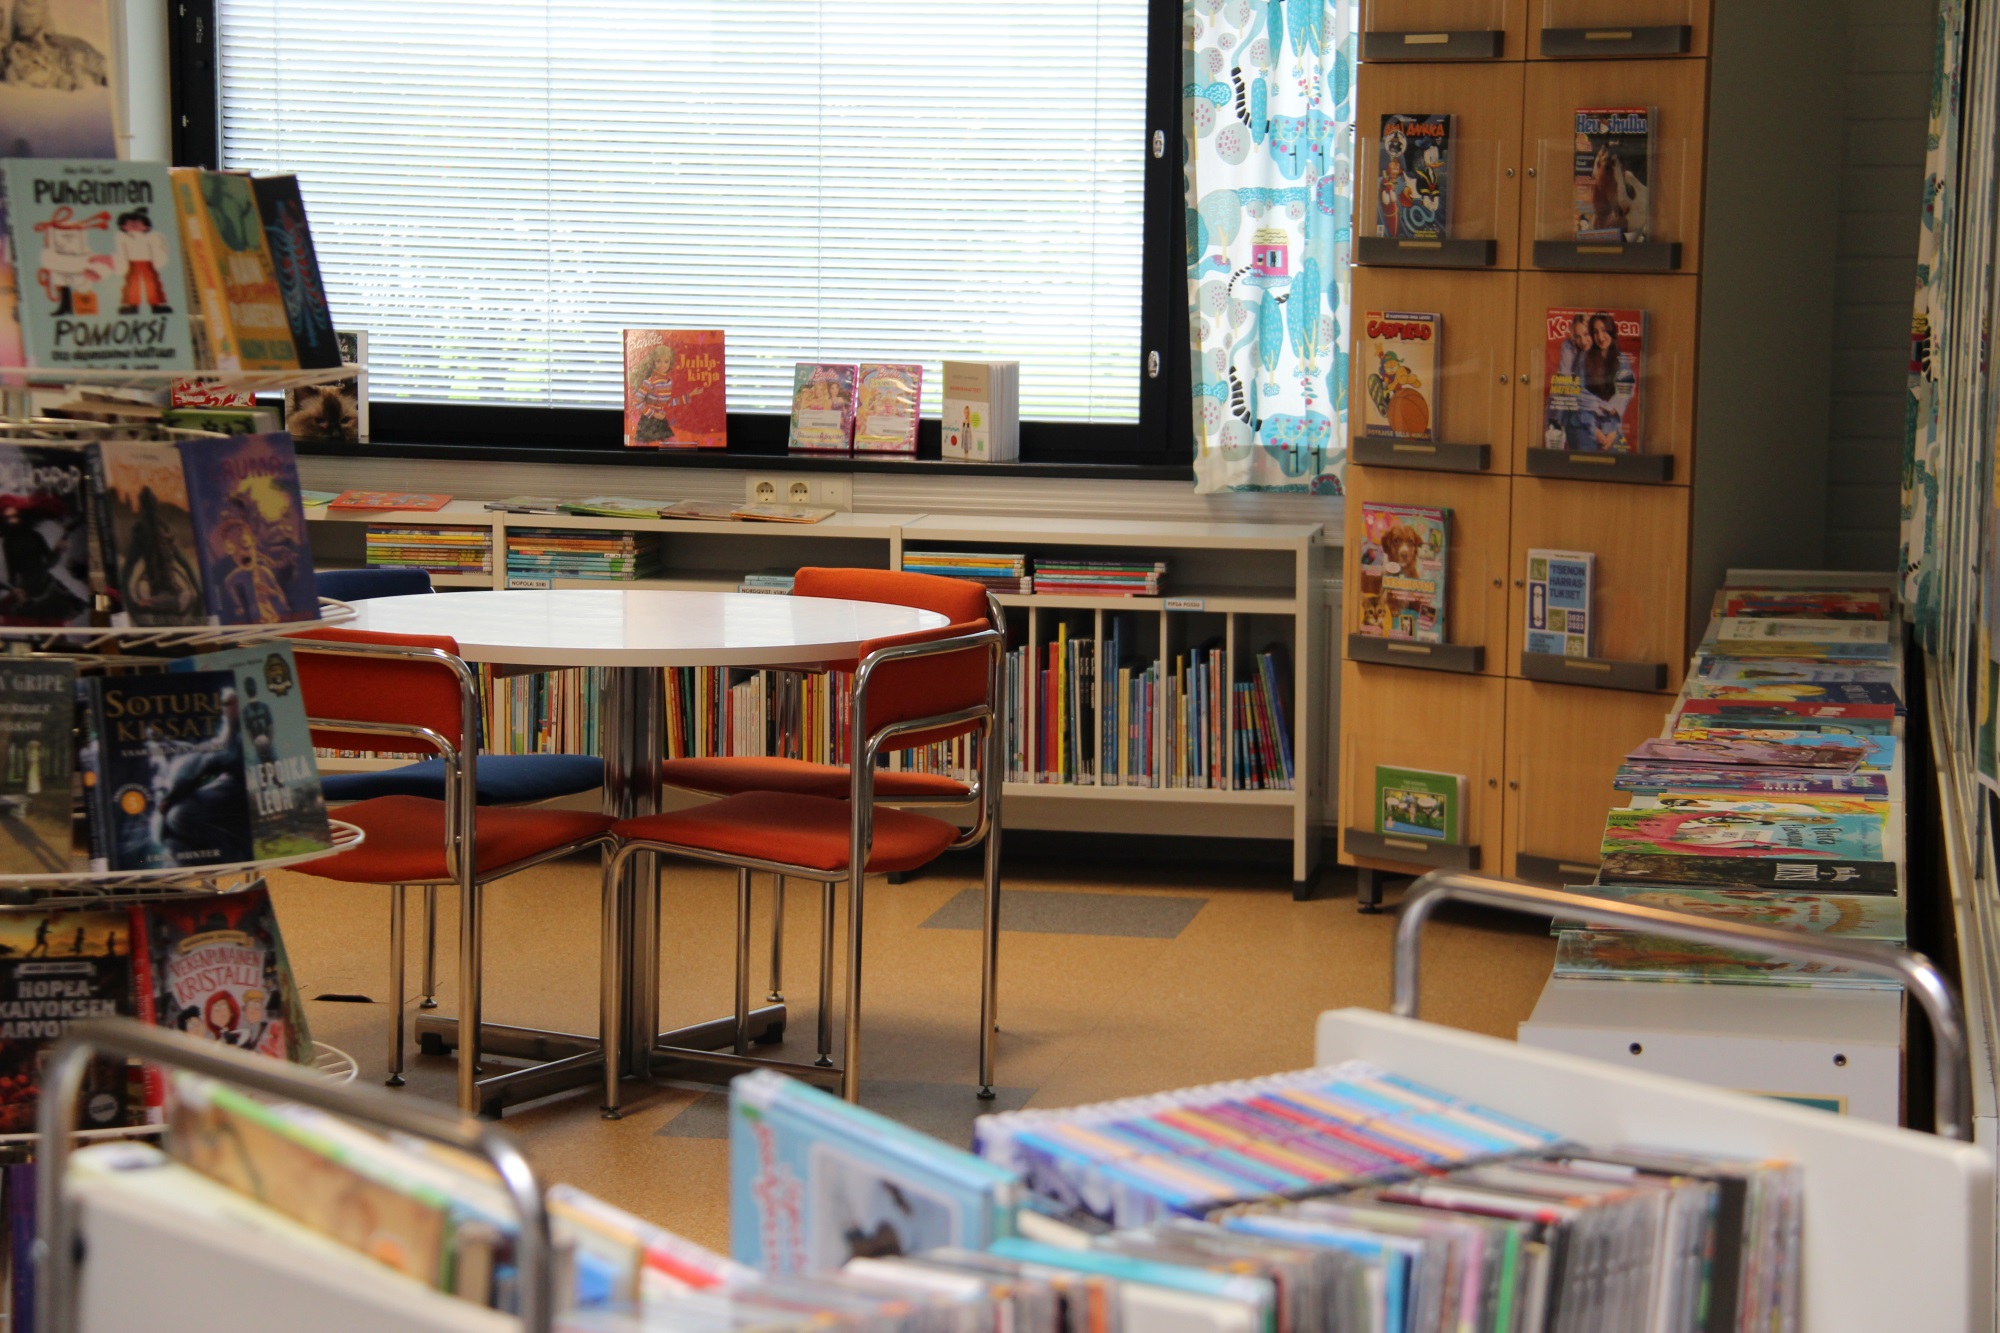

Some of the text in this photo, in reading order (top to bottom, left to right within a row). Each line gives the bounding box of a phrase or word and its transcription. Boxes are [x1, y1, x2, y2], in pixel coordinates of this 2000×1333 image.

[1406, 122, 1445, 136] ANKKA
[1575, 113, 1648, 134] Hevshullu
[1367, 320, 1432, 341] GARFIELD
[628, 330, 663, 352] Barbie
[676, 353, 720, 370] Juhla-
[687, 367, 720, 387] kirja
[812, 365, 839, 380] Barbie
[1549, 588, 1581, 600] TUKSET
[1567, 613, 1585, 622] 2022
[1567, 621, 1585, 631] 2023
[105, 689, 222, 719] SOTURI
[117, 716, 217, 742] KISSAT
[17, 979, 99, 999] HOPEA-
[174, 965, 259, 1004] KRISTALLI
